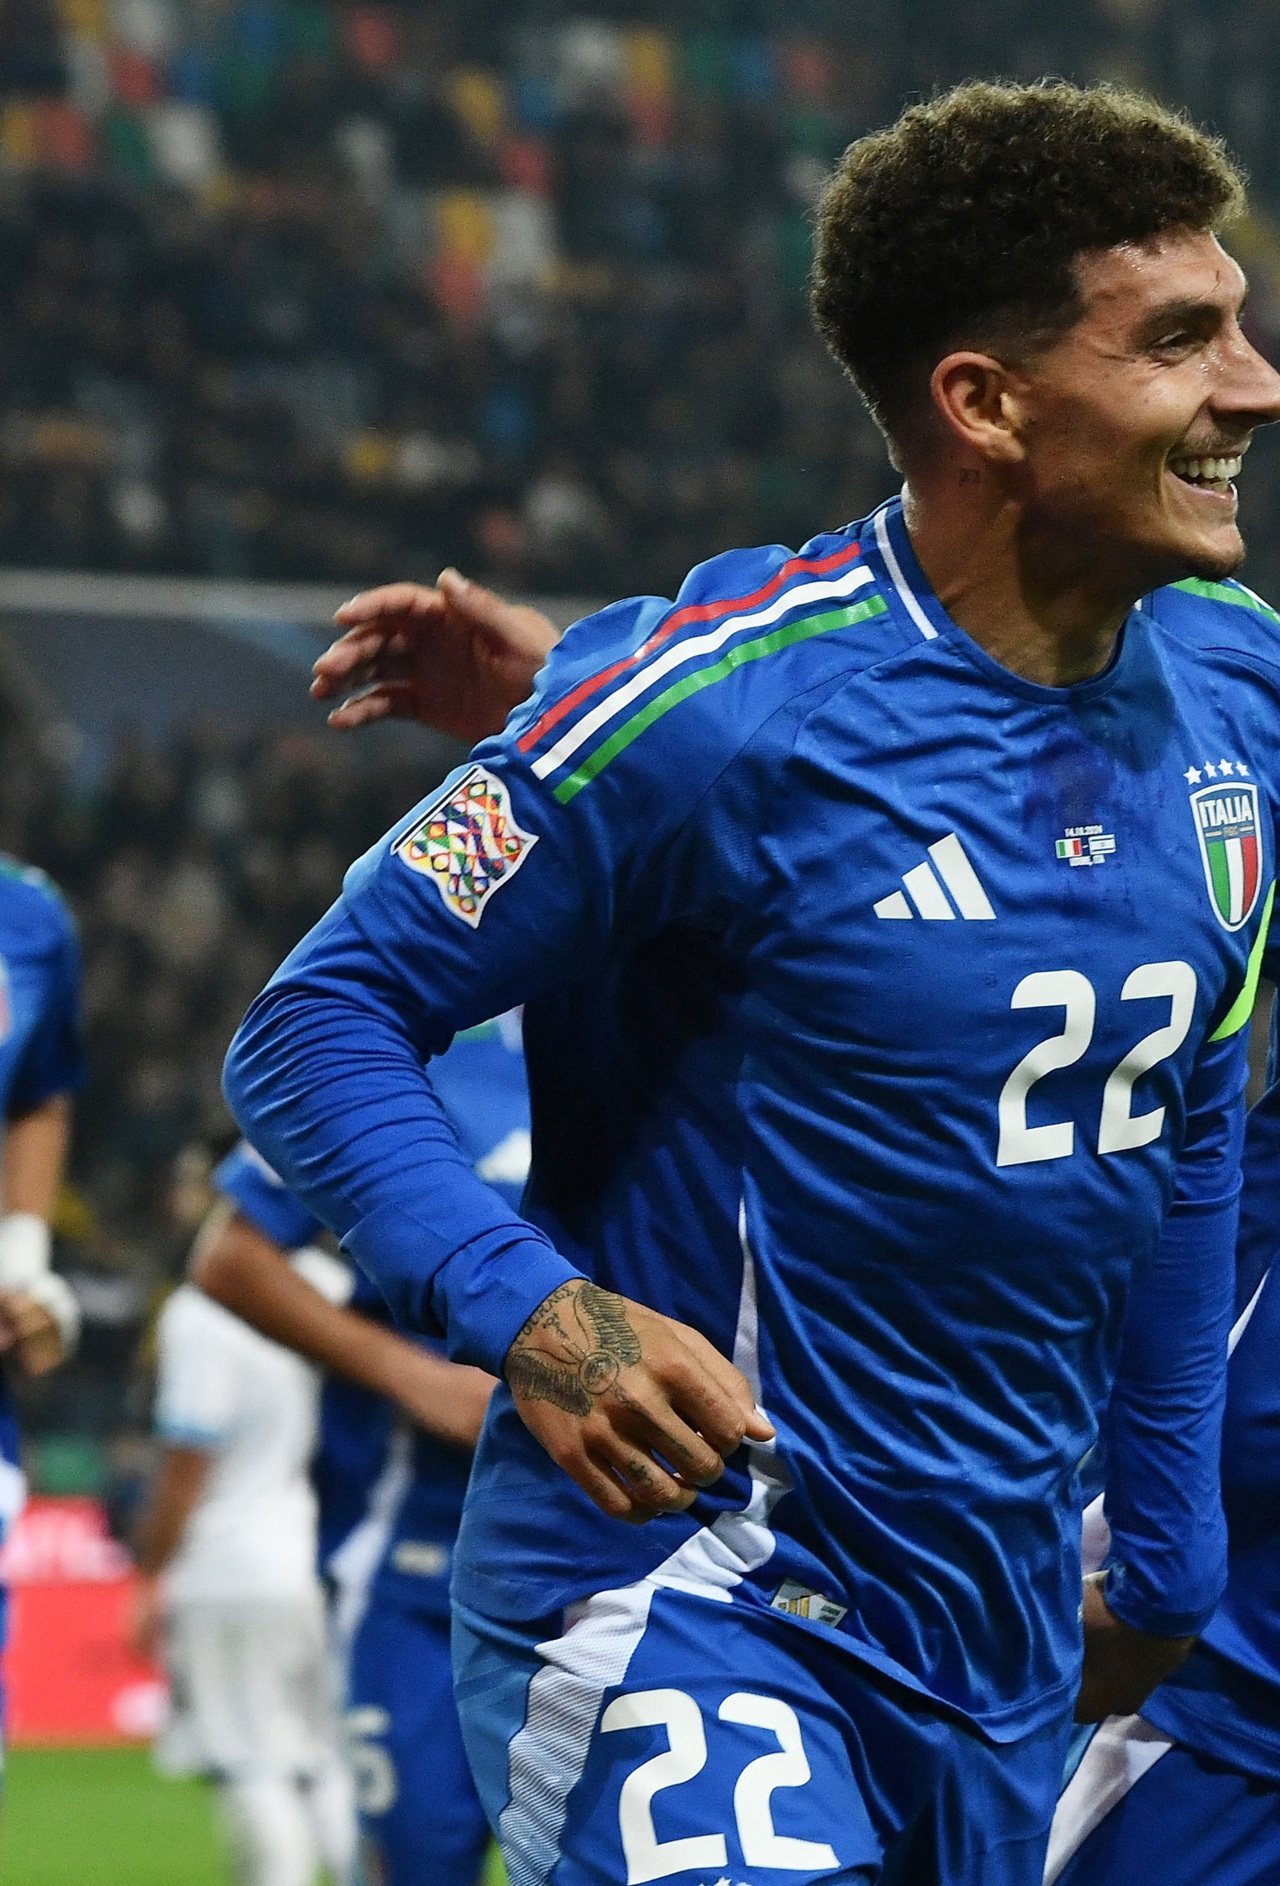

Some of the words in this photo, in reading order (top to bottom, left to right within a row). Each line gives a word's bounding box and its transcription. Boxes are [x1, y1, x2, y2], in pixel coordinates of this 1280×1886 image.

[1198, 795, 1254, 828] ITALIA
[996, 960, 1197, 1167] 22
[601, 1688, 841, 1886] 22
